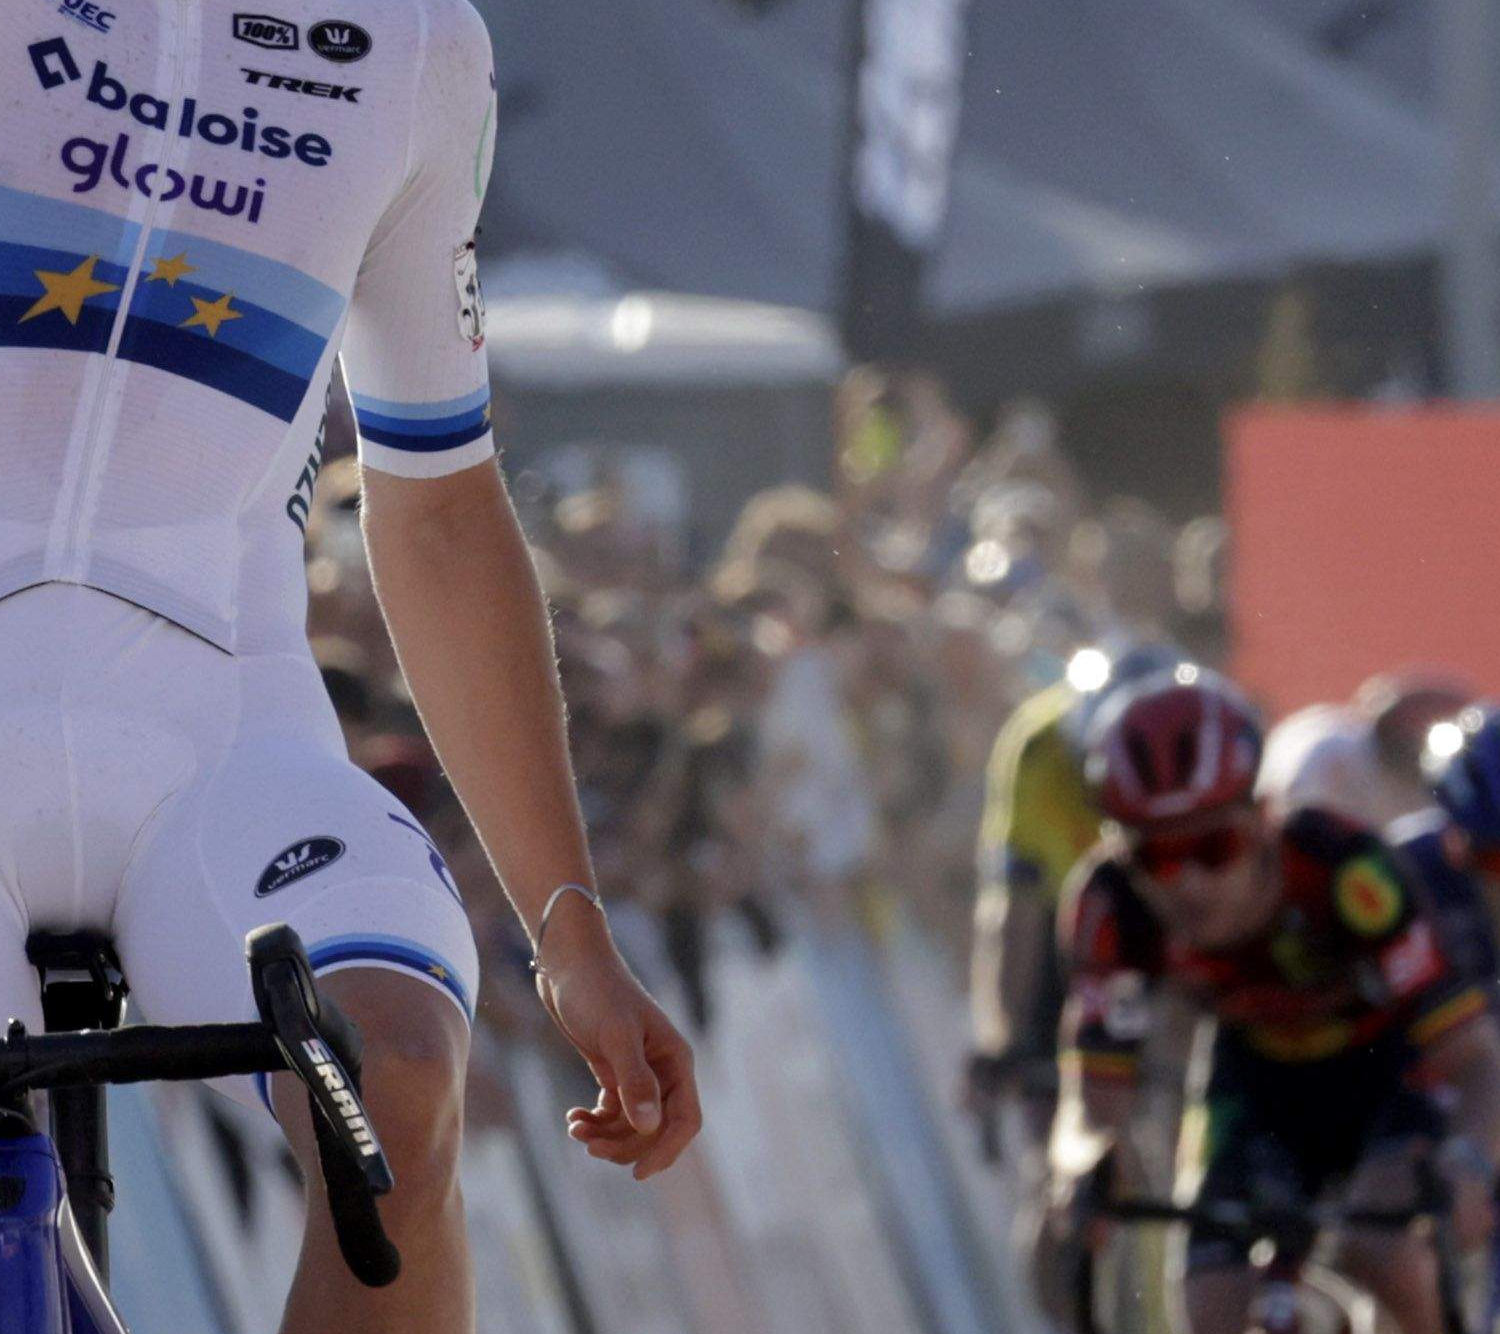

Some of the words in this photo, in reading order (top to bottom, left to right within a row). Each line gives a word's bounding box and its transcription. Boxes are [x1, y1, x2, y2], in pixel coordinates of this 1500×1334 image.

[242, 21, 291, 45] 100%
[86, 60, 333, 167] baloise
[240, 67, 363, 104] TREK
[60, 132, 267, 223] glowi
[300, 1038, 380, 1157] SRAM
